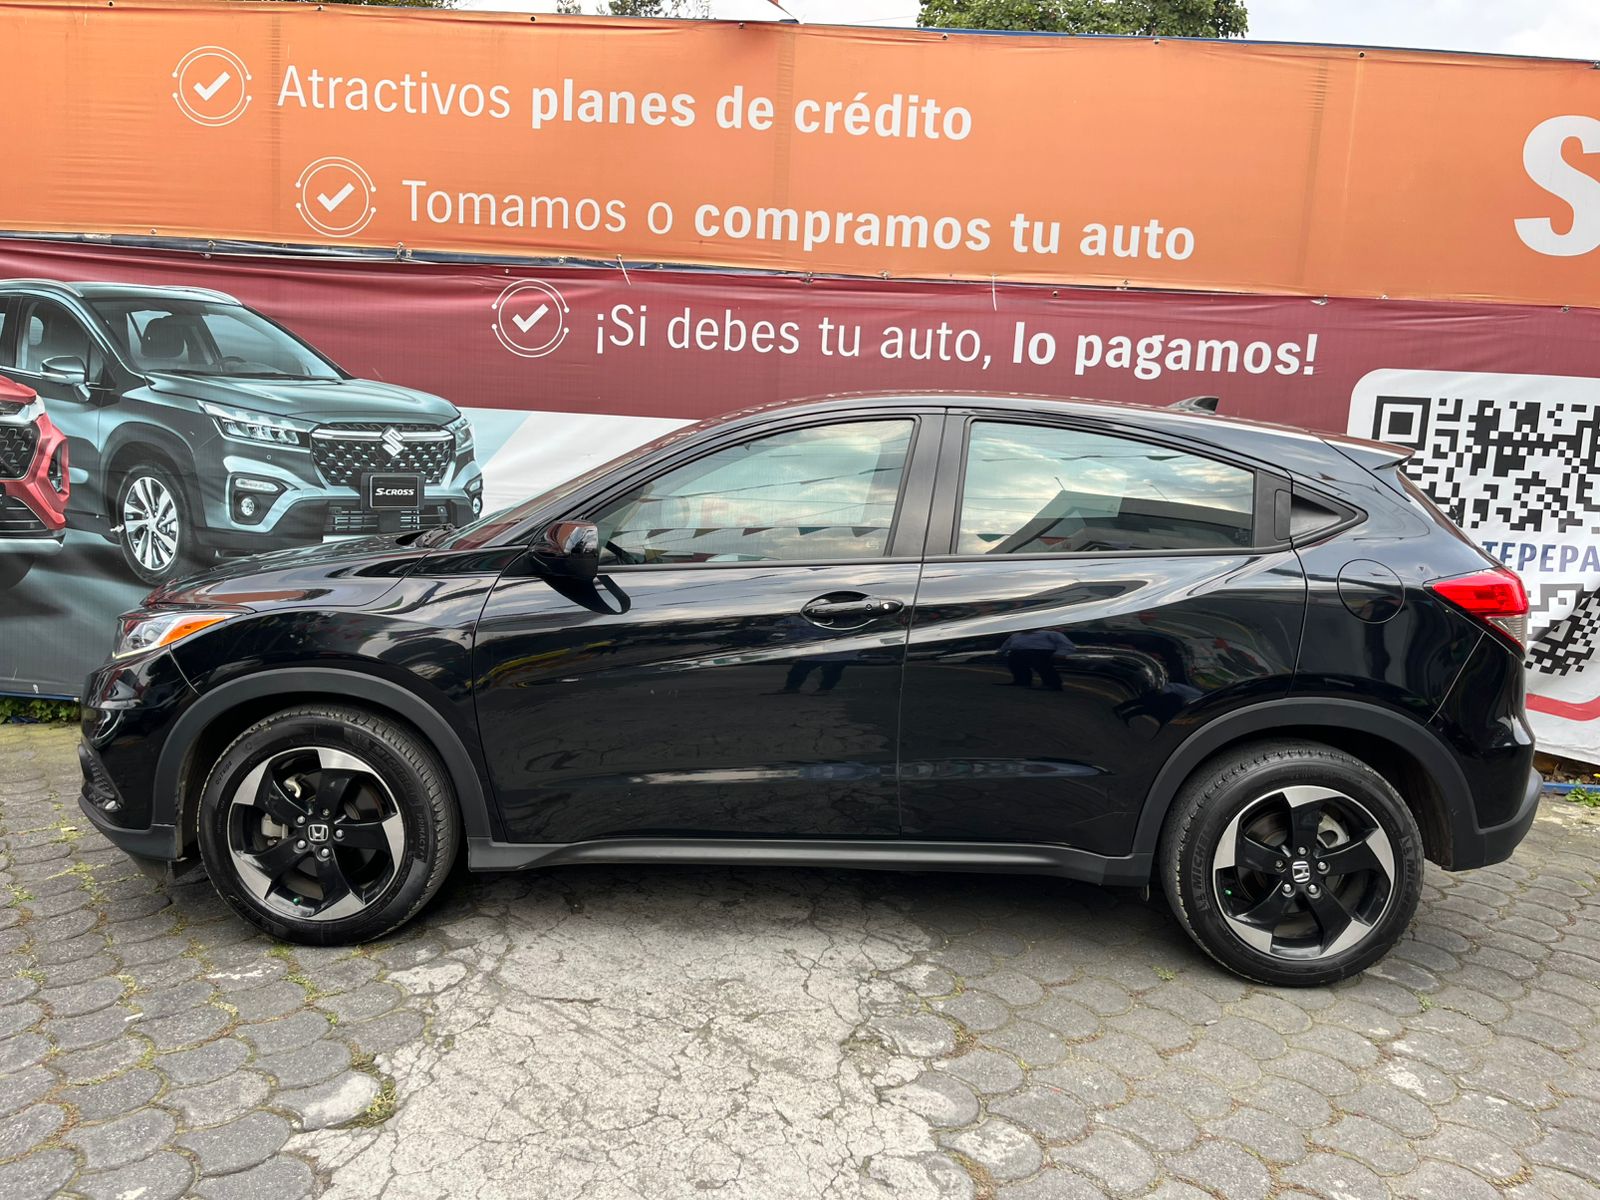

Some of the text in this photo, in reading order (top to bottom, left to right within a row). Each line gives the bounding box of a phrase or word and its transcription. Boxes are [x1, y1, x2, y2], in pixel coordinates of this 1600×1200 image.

[278, 66, 972, 141] Atractivos planes de crédito
[401, 179, 1195, 261] Tomamos o compramos tu auto
[596, 303, 1319, 380] ¡Si debes tu auto, lo pagamos!
